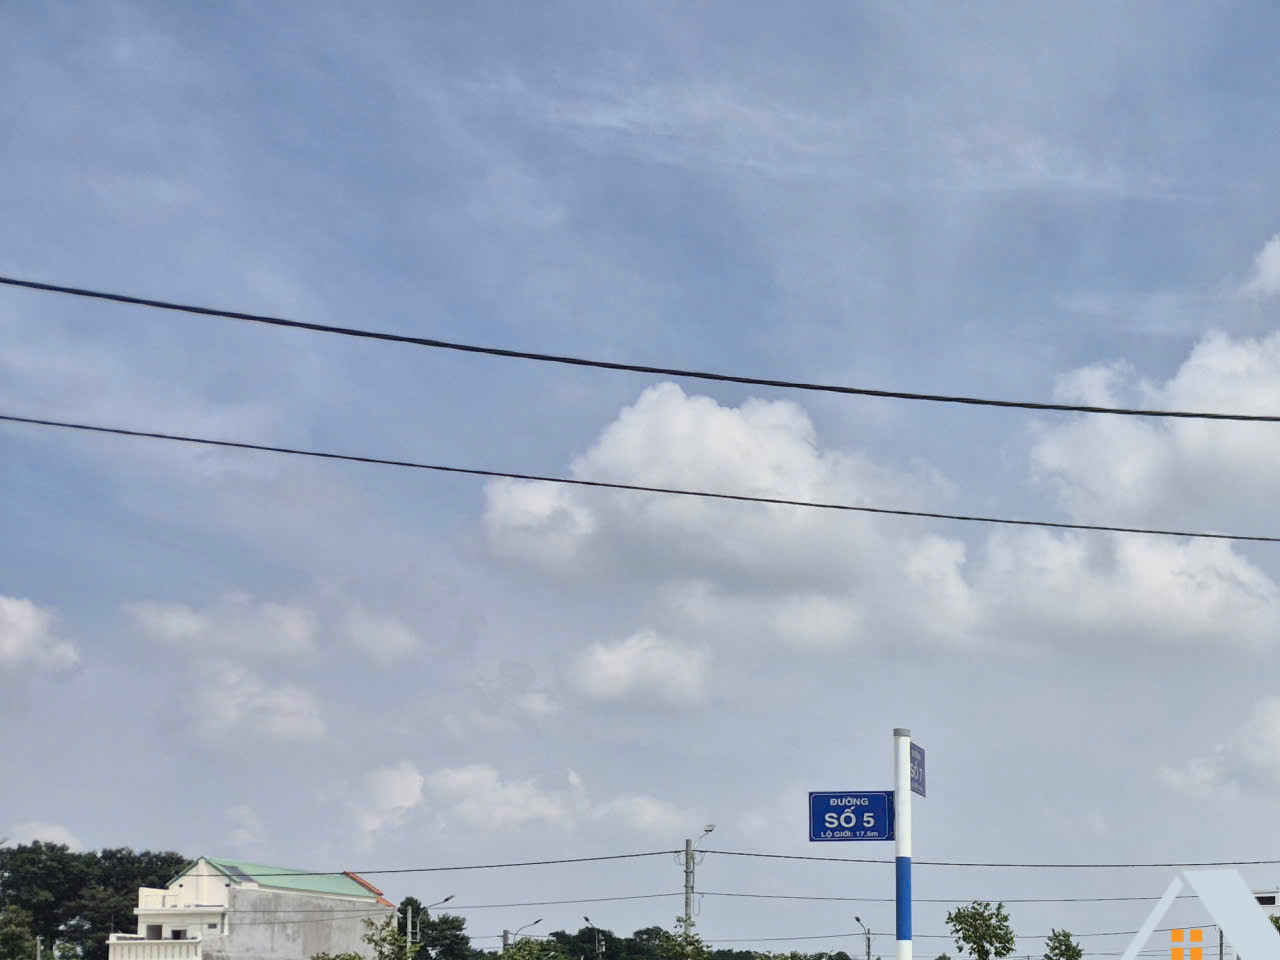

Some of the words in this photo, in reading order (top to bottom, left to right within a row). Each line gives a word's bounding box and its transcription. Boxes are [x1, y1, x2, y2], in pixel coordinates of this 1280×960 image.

[830, 797, 869, 806] ĐƯỜNG
[824, 806, 857, 828] SỐ
[863, 812, 875, 828] 5
